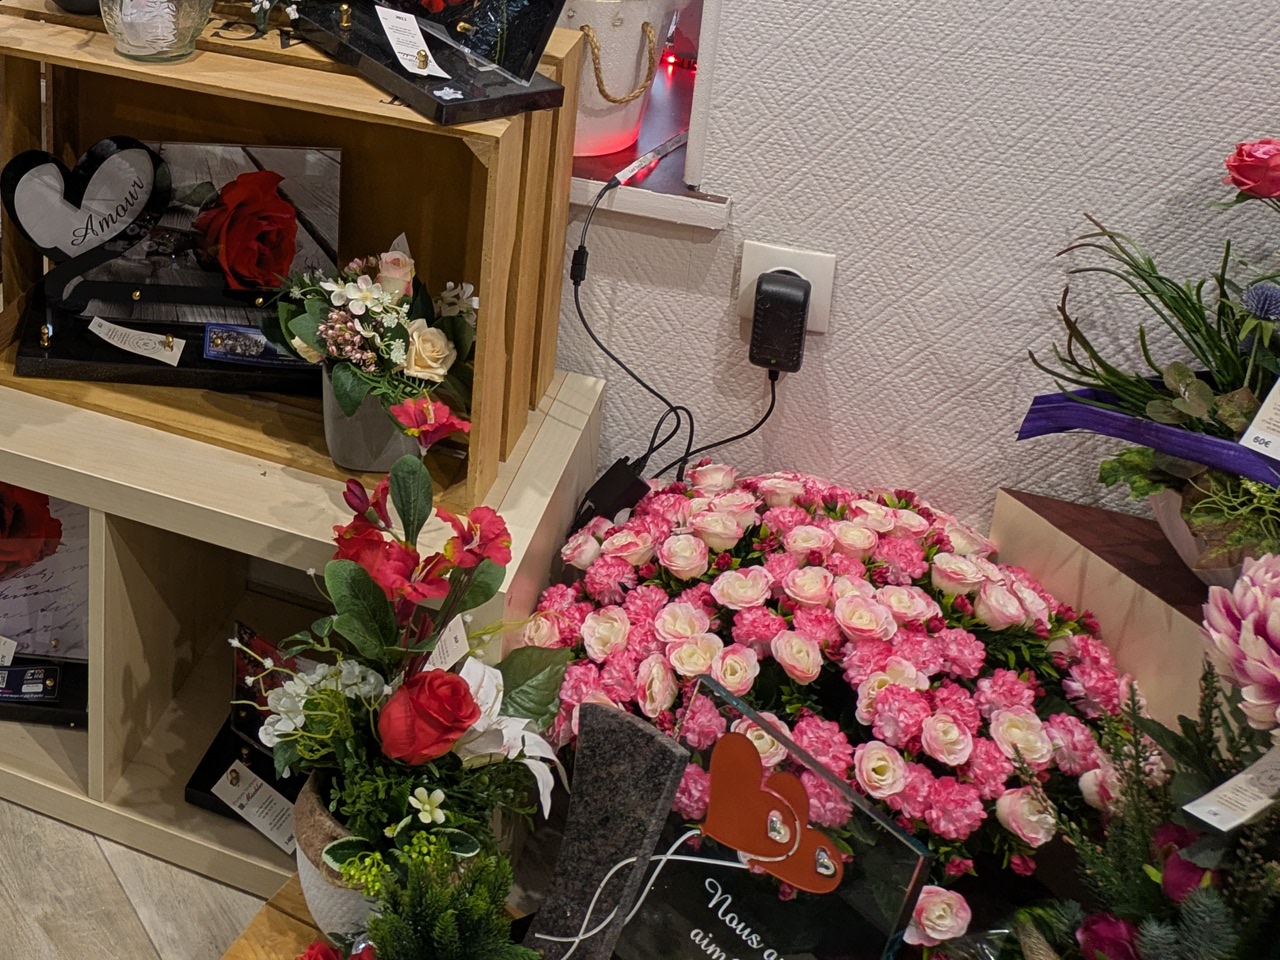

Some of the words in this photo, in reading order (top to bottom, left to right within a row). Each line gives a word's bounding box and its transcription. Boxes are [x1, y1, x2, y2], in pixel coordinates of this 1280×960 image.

[71, 176, 144, 246] Amour
[1253, 435, 1272, 448] 60€
[690, 928, 740, 960] aim
[705, 877, 765, 950] Nous
[763, 948, 784, 960] a
